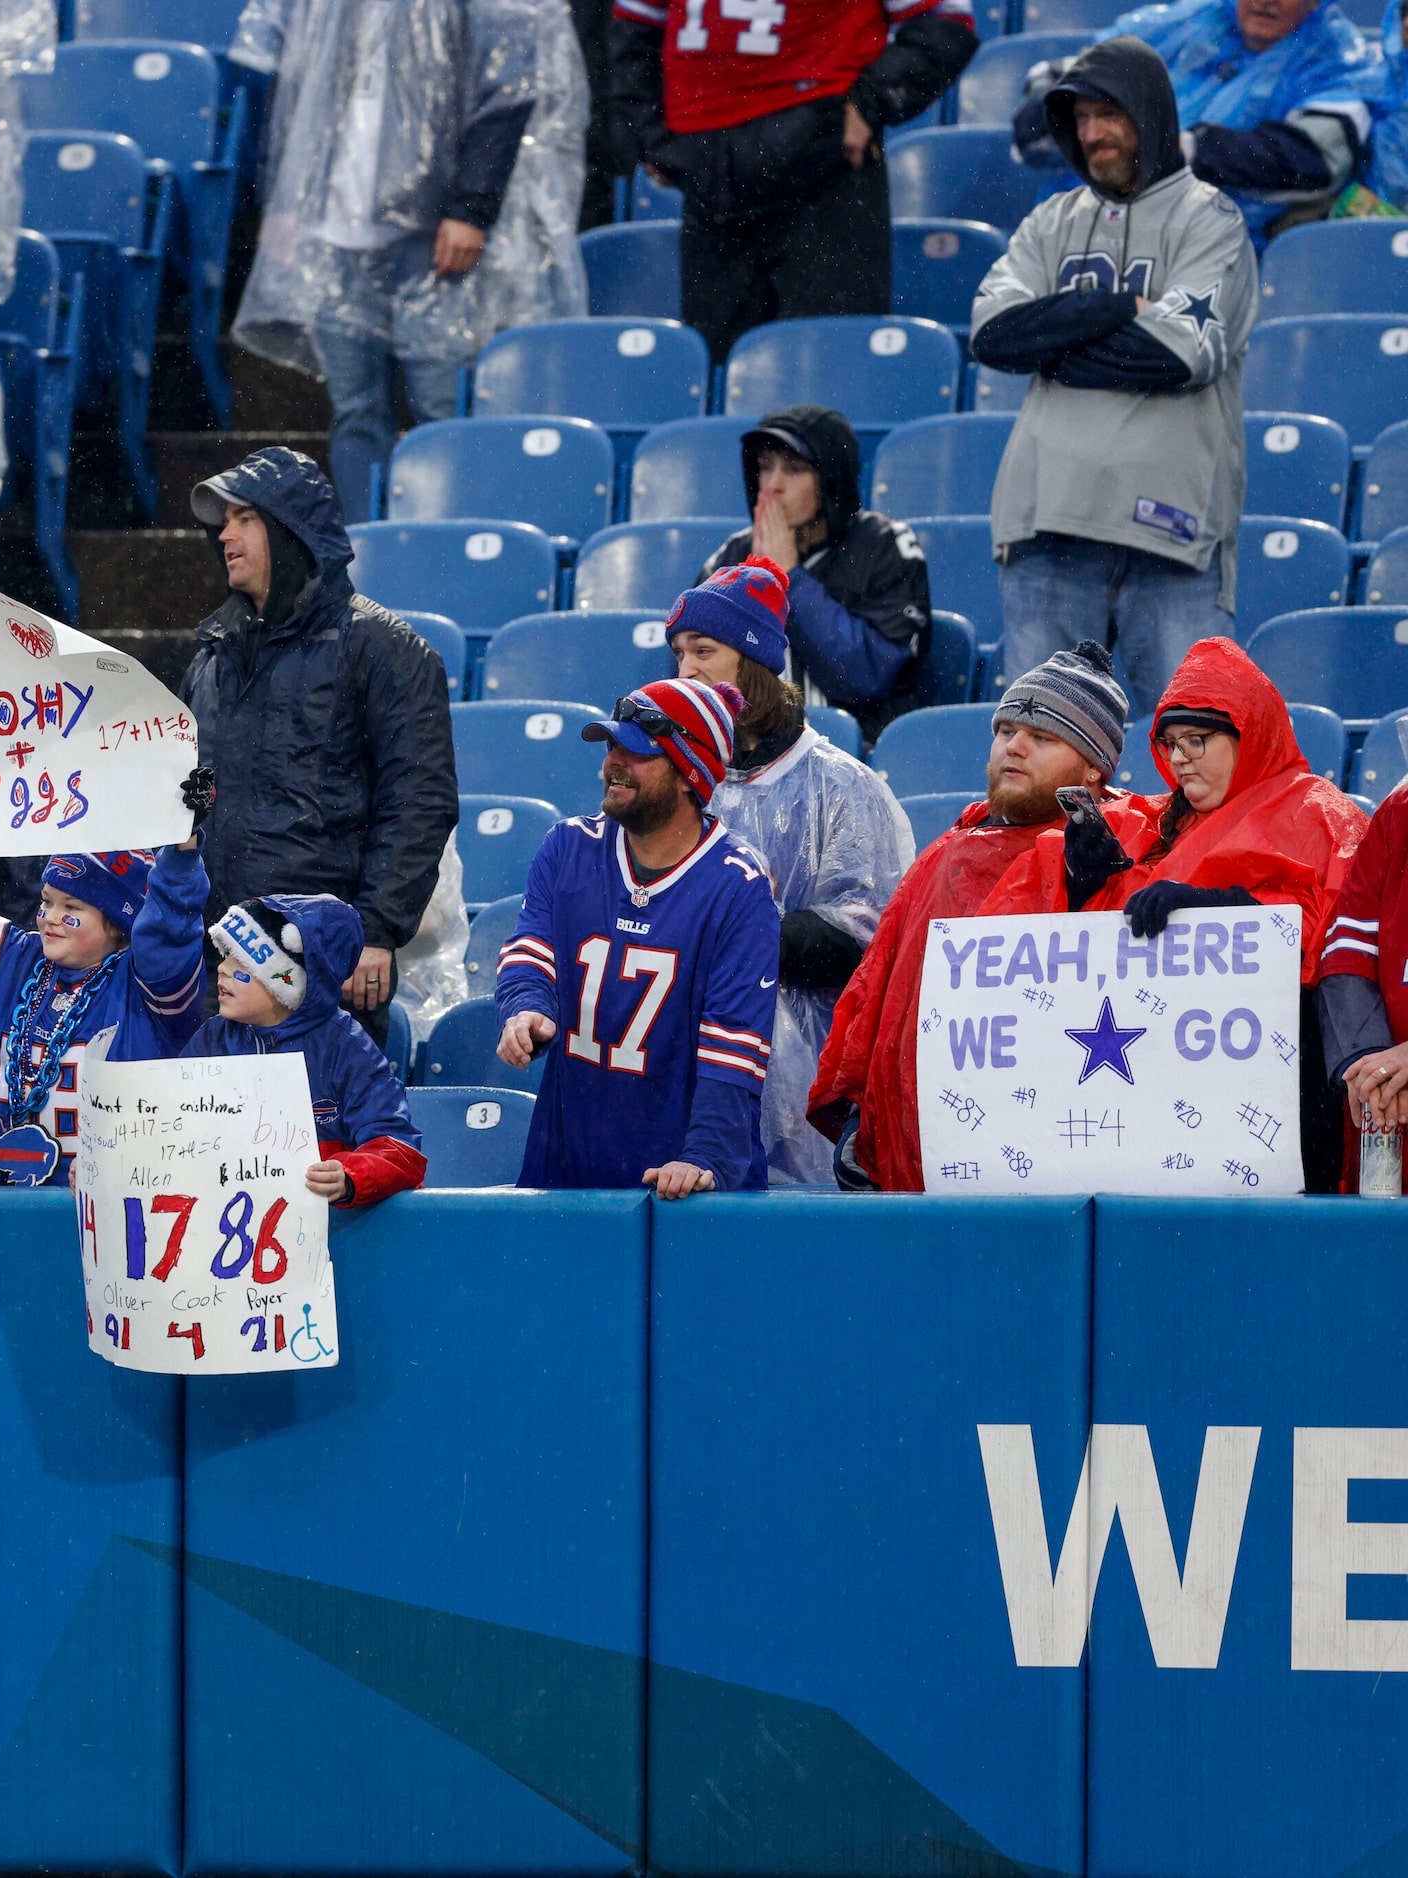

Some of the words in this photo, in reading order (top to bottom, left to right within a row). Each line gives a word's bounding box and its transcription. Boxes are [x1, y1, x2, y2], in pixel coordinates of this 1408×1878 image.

[615, 916, 651, 935] BILLS
[1270, 911, 1301, 947] #28
[941, 929, 1107, 993] YEAH,
[1116, 920, 1261, 980] HERE
[566, 933, 679, 1076] 17
[1021, 986, 1056, 1013] #97
[1135, 986, 1168, 1017] #73
[920, 1007, 943, 1035] #3
[948, 1014, 1019, 1072] WE
[1174, 1007, 1263, 1062] GO
[938, 1087, 987, 1132] #87
[1010, 1086, 1038, 1110] #9
[1173, 1098, 1203, 1130] #20
[479, 1106, 489, 1125] 3
[1056, 1108, 1126, 1148] #4
[1235, 1100, 1283, 1153] #11
[1362, 1135, 1403, 1148] LIGH
[128, 1165, 173, 1188] Allen
[235, 1154, 286, 1182] dalton
[940, 1161, 983, 1181] #17
[1000, 1144, 1034, 1180] #88
[1160, 1151, 1195, 1171] #26
[1221, 1157, 1260, 1189] #90
[123, 1193, 200, 1283] 17
[210, 1190, 289, 1285] 86
[103, 1284, 154, 1312] Oliver
[171, 1284, 228, 1312] Cook
[246, 1287, 289, 1318] Poyer
[105, 1313, 131, 1350] 91
[167, 1321, 206, 1361] 4
[240, 1313, 288, 1354] 21
